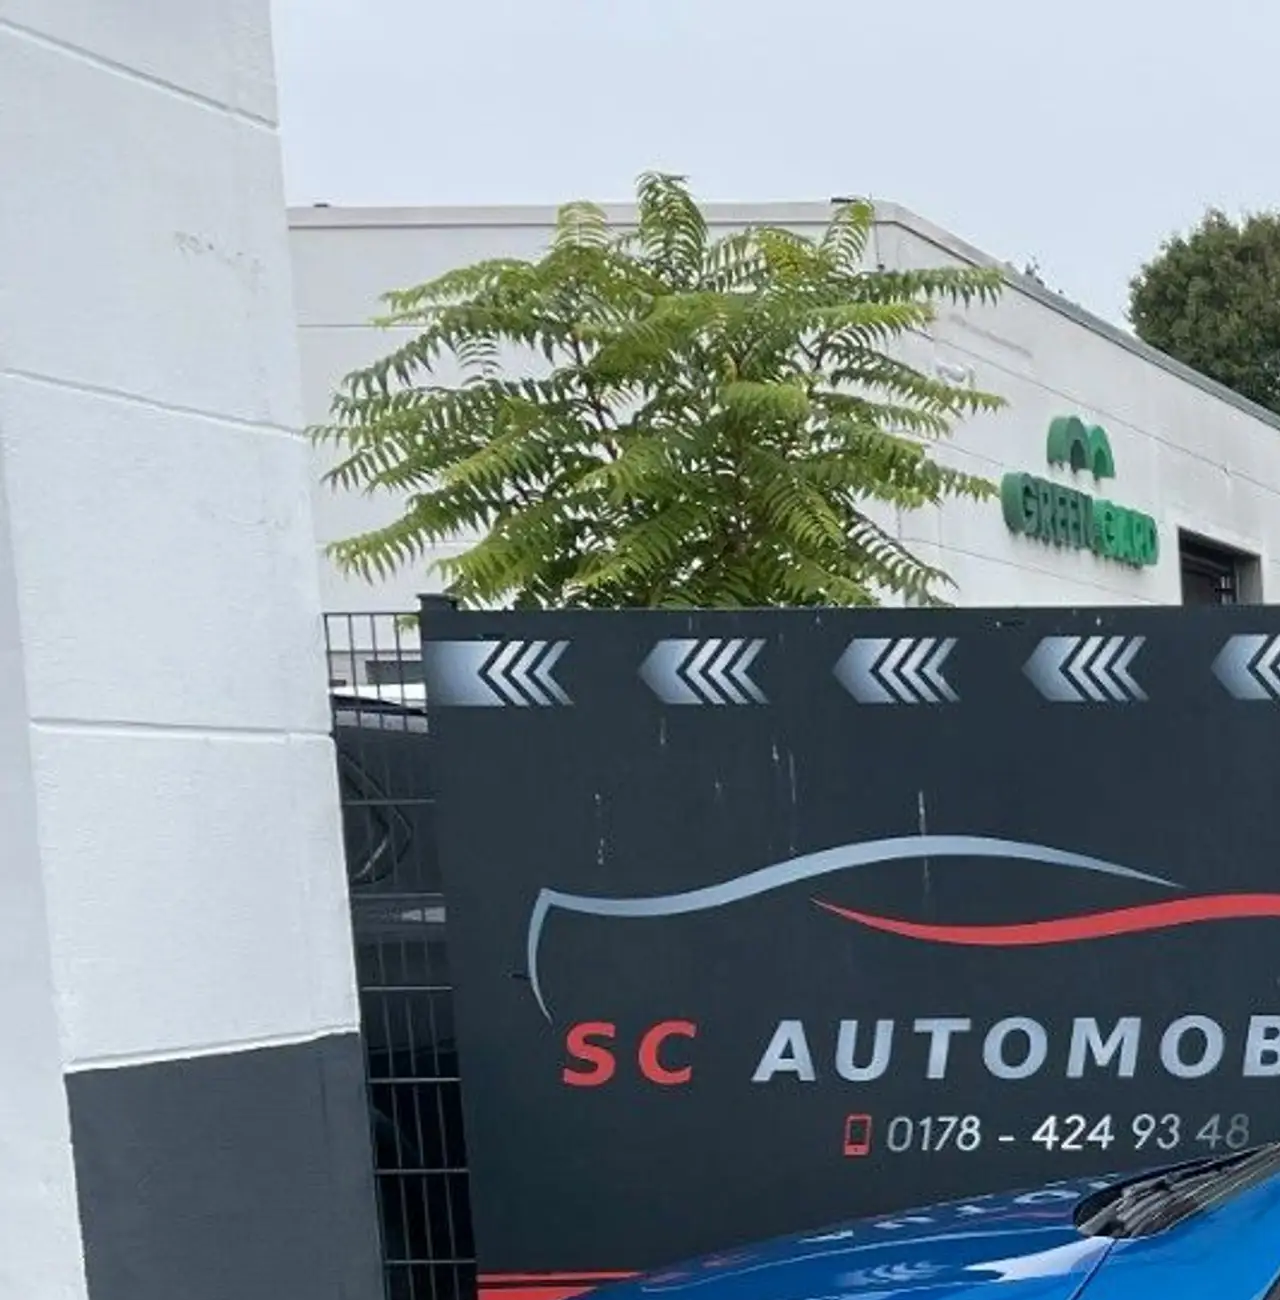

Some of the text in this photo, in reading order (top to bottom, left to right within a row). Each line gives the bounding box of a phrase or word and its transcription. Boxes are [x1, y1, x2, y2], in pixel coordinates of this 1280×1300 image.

[562, 1019, 698, 1086] SC
[887, 1115, 982, 1152] 0178
[1031, 1113, 1115, 1152] 424
[1131, 1113, 1182, 1151] 93
[1195, 1113, 1250, 1150] 48
